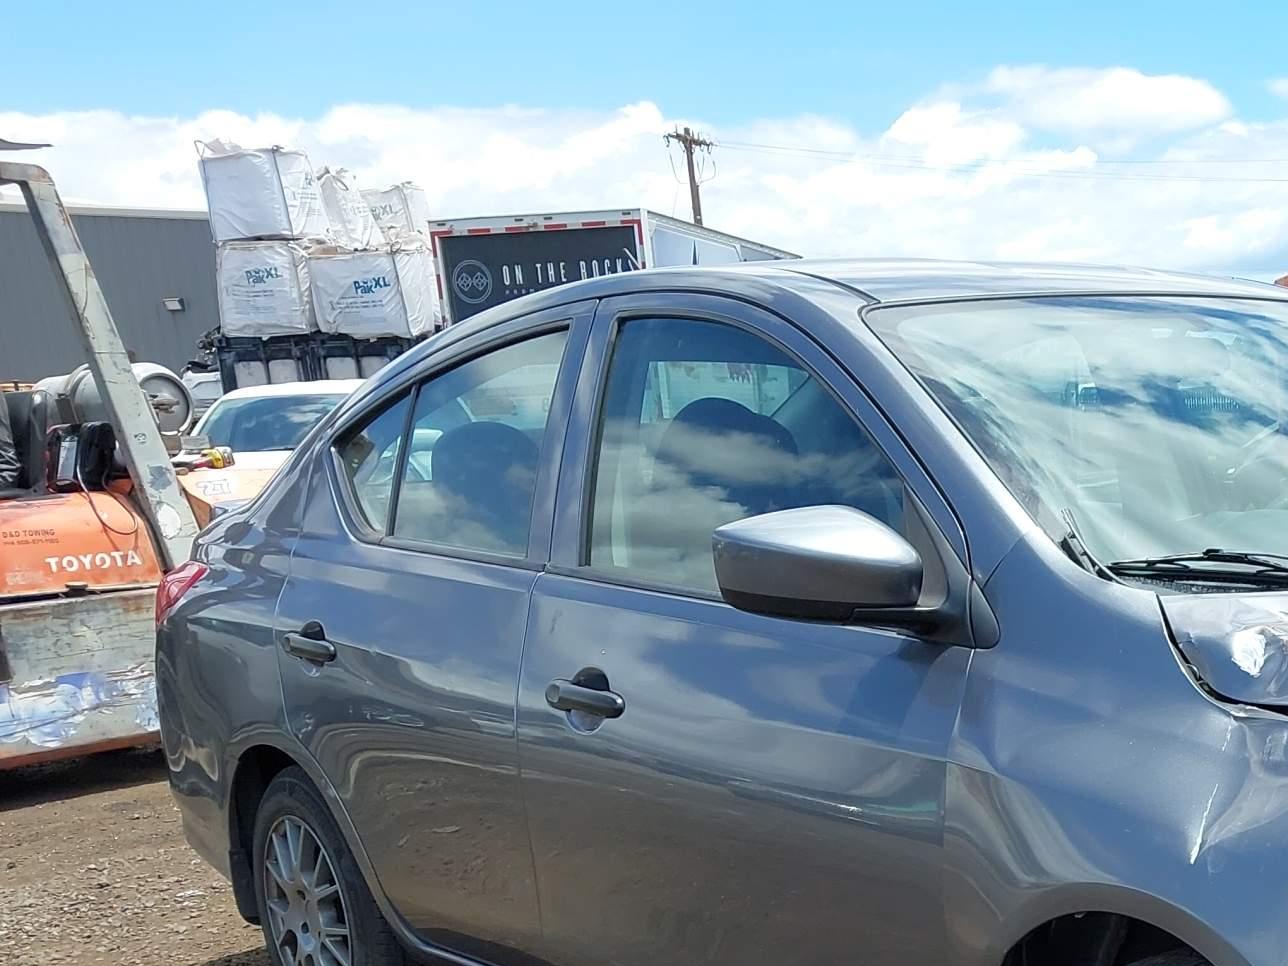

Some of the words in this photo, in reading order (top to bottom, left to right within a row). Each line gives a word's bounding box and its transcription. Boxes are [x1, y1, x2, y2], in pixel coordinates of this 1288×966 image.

[502, 265, 523, 285] ON
[535, 262, 567, 283] THE
[22, 528, 56, 537] TOWING
[45, 549, 142, 573] TOYOTA
